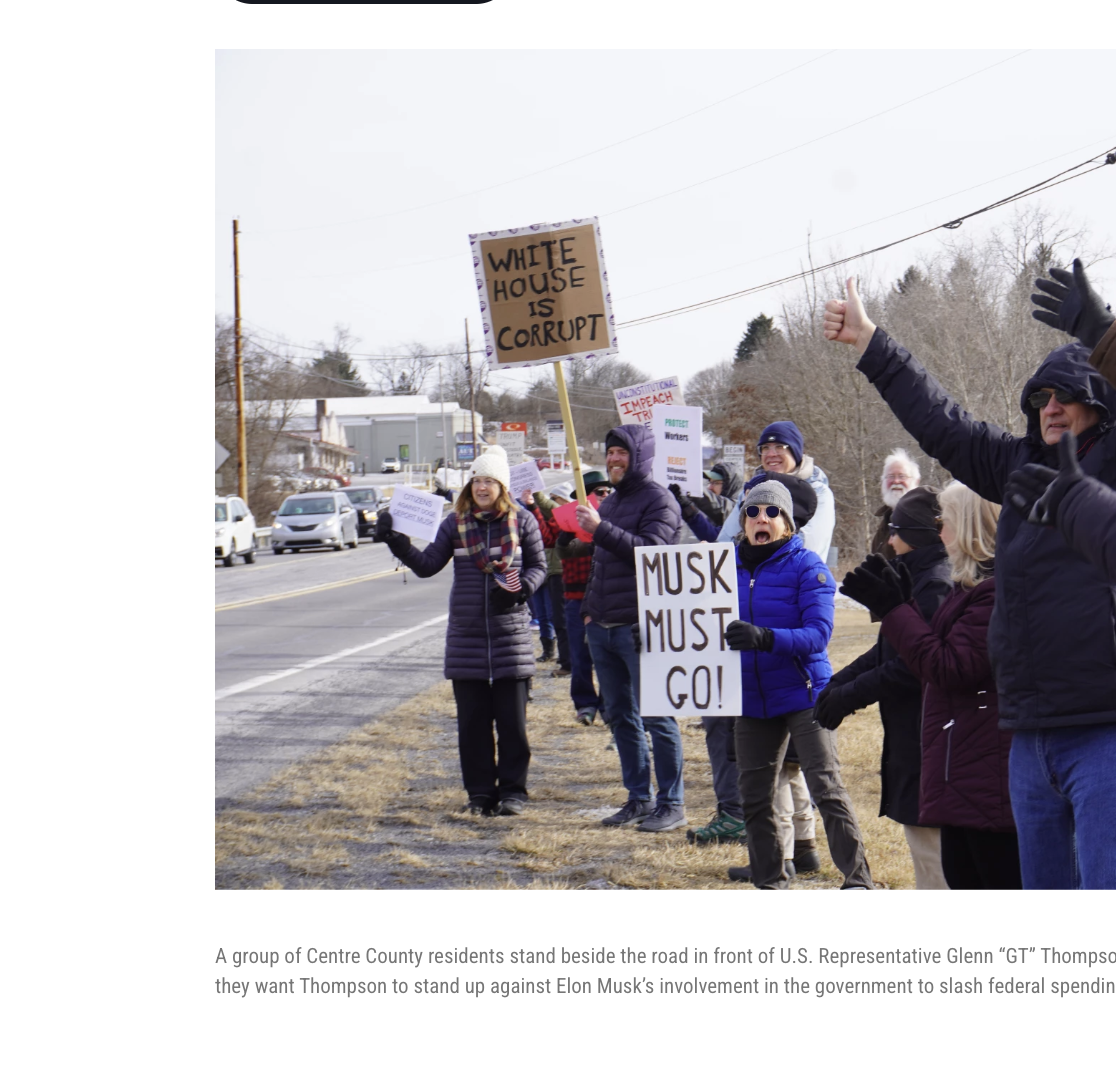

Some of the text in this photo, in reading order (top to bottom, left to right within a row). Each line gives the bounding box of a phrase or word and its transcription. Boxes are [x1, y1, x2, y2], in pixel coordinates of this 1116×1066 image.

[488, 237, 577, 272] WHITE
[494, 266, 585, 302] HOUSE
[528, 298, 555, 318] IS
[497, 314, 604, 351] CORRUPT
[620, 391, 673, 414] IMPEACH
[665, 418, 689, 428] PROTECT
[664, 431, 689, 441] Workers
[667, 456, 687, 465] REJECT
[403, 493, 433, 508] CITIZENS
[642, 549, 732, 596] MUSK
[645, 607, 732, 653] MUST
[666, 665, 723, 710] GO!
[215, 977, 249, 998] they
[255, 979, 294, 993] want
[300, 977, 386, 997] Thompson
[392, 979, 408, 993] to
[415, 977, 459, 993] stand
[466, 982, 484, 997] up
[491, 978, 551, 998] against
[557, 977, 591, 993] Elon
[598, 977, 653, 993] Musk’s
[661, 977, 759, 993] involvement
[765, 978, 778, 993] in
[784, 977, 809, 993] the
[816, 979, 912, 998] government
[918, 979, 934, 993] to
[940, 977, 982, 993] slash
[989, 977, 1044, 993] federal
